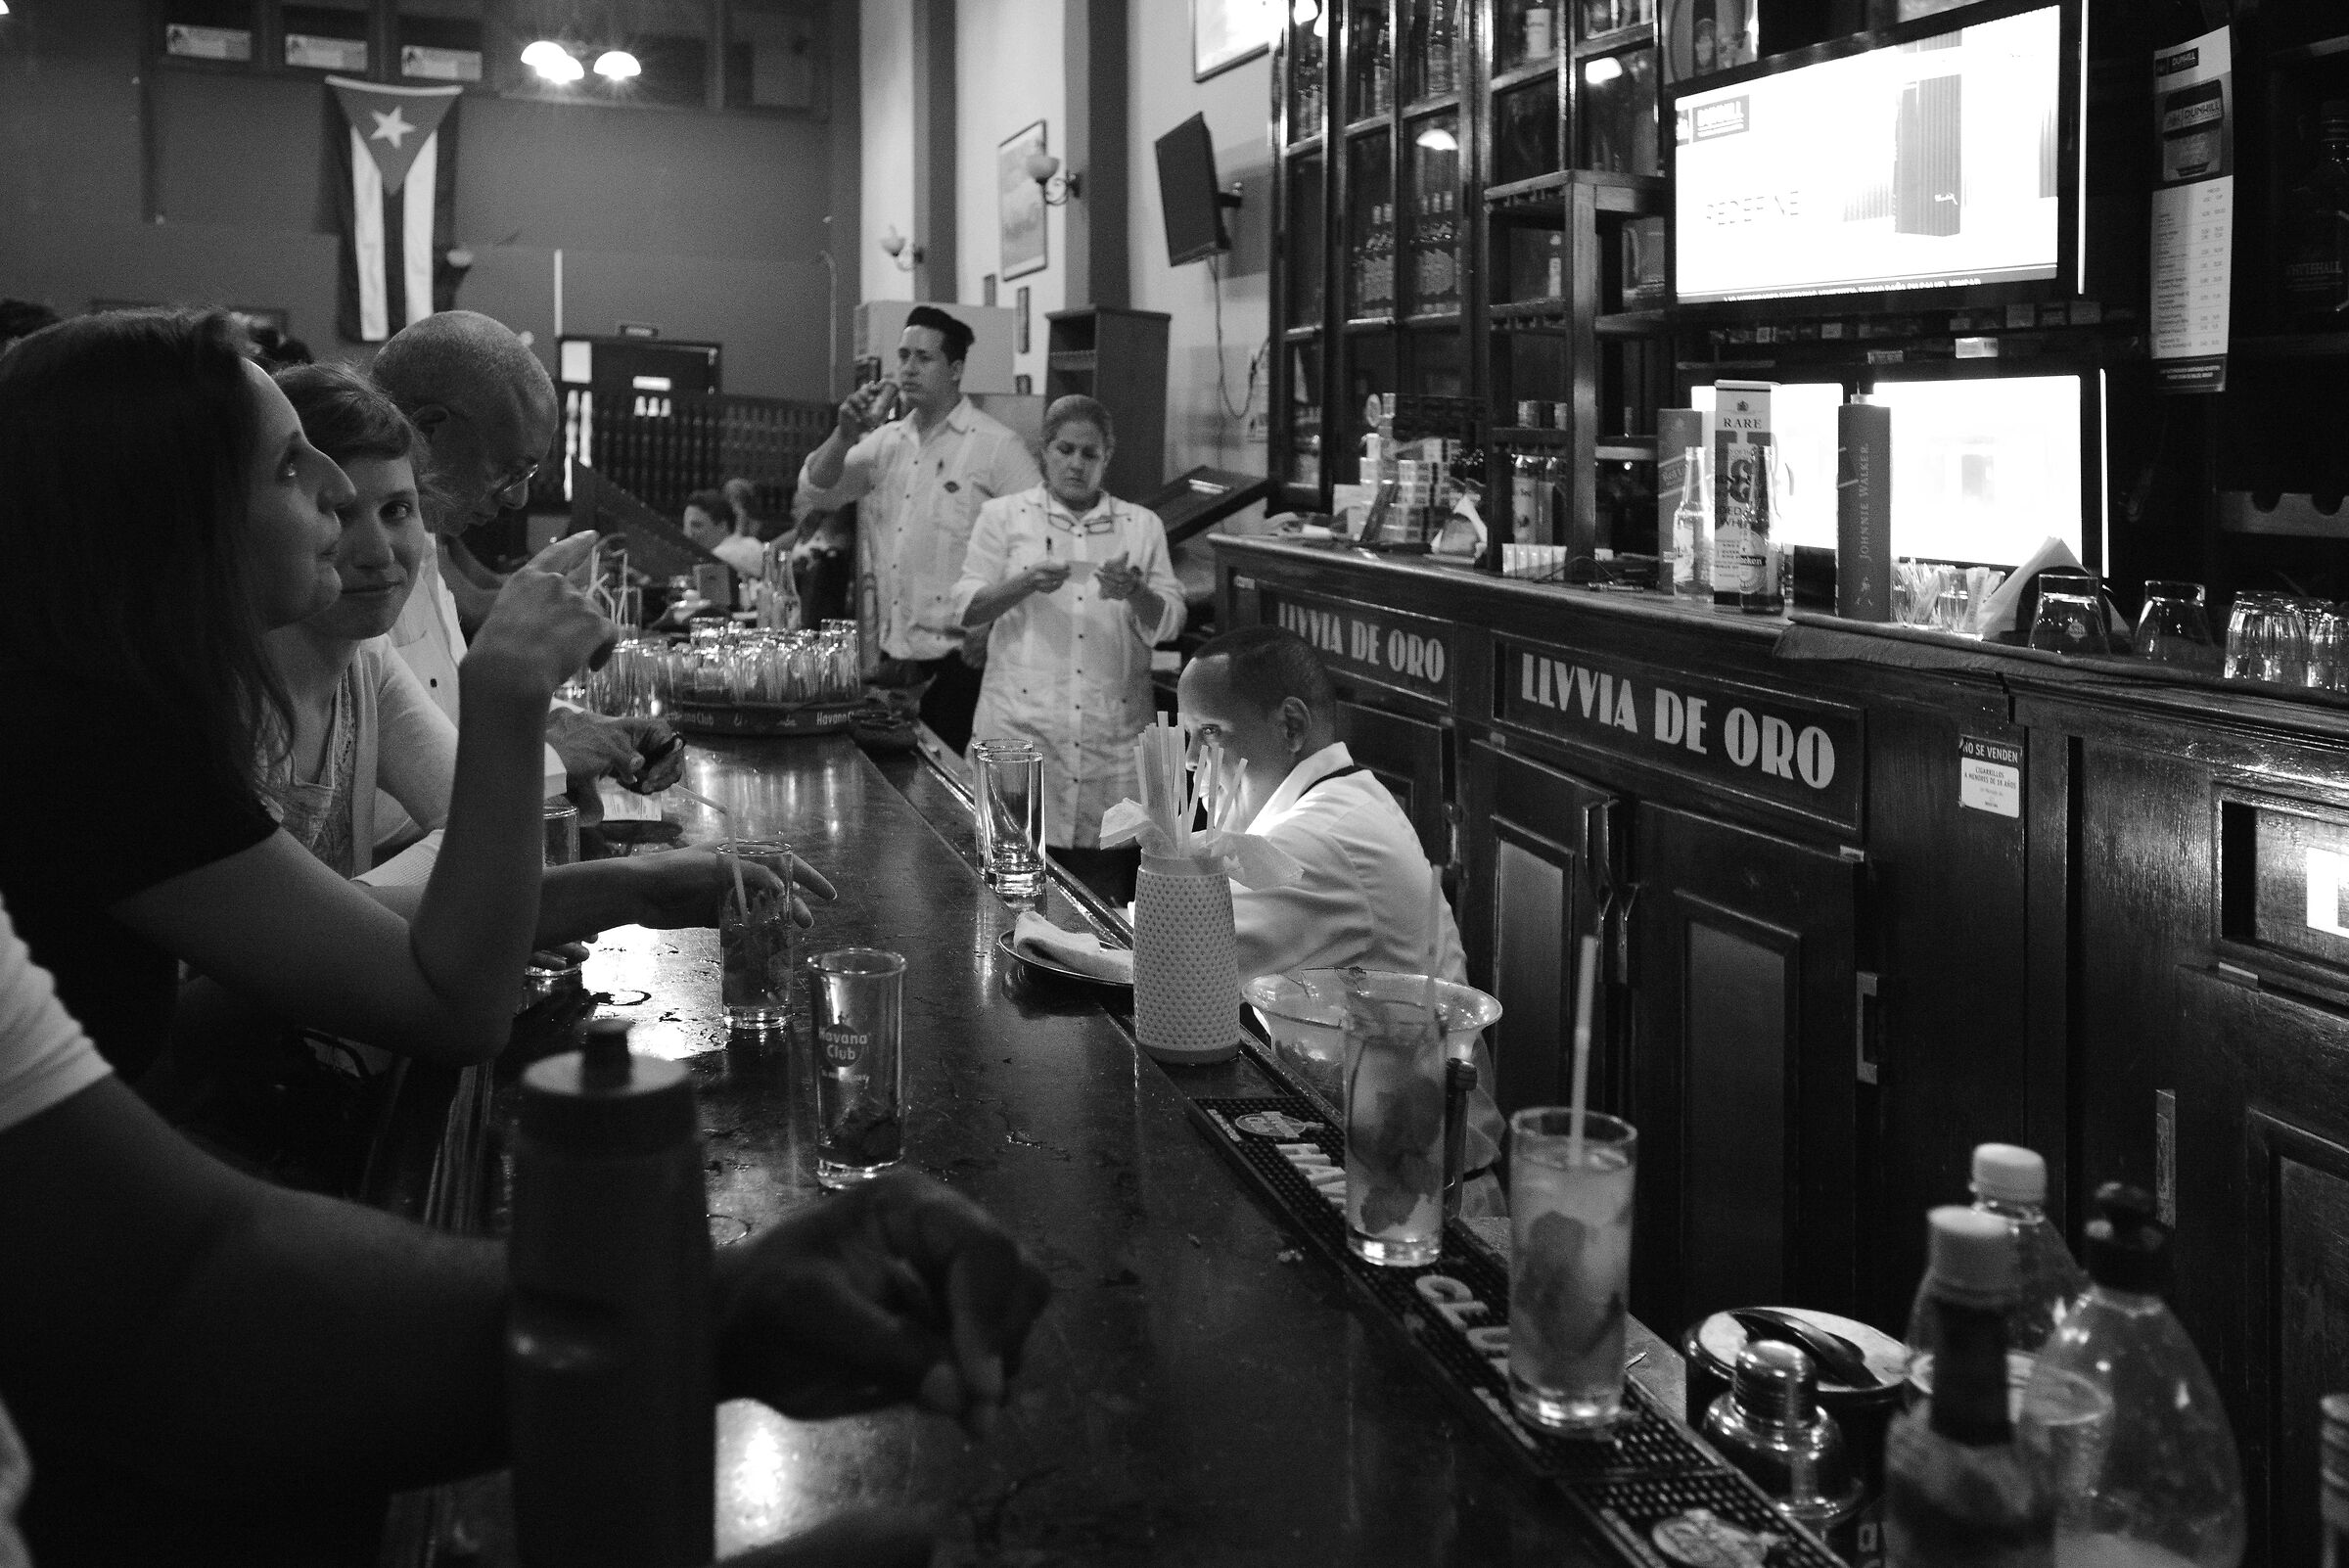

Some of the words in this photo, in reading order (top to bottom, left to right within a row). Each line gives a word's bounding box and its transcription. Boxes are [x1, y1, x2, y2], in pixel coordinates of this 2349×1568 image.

[2184, 101, 2220, 119] DUNHILL
[1723, 417, 1763, 429] RARE
[1858, 444, 1869, 497] WALKER
[1858, 501, 1871, 562] JOHNNIE
[1352, 619, 1381, 667] DE
[1388, 628, 1446, 683] ORO
[816, 712, 847, 726] Havana
[1654, 687, 1708, 755] DE
[1724, 707, 1836, 790] ORO
[1962, 742, 1973, 755] NO
[1975, 744, 1985, 757] SE
[1986, 746, 2018, 763] VENDEN
[818, 1027, 868, 1045] Havana
[826, 1043, 856, 1060] Club
[1415, 1274, 1510, 1376] CLU
